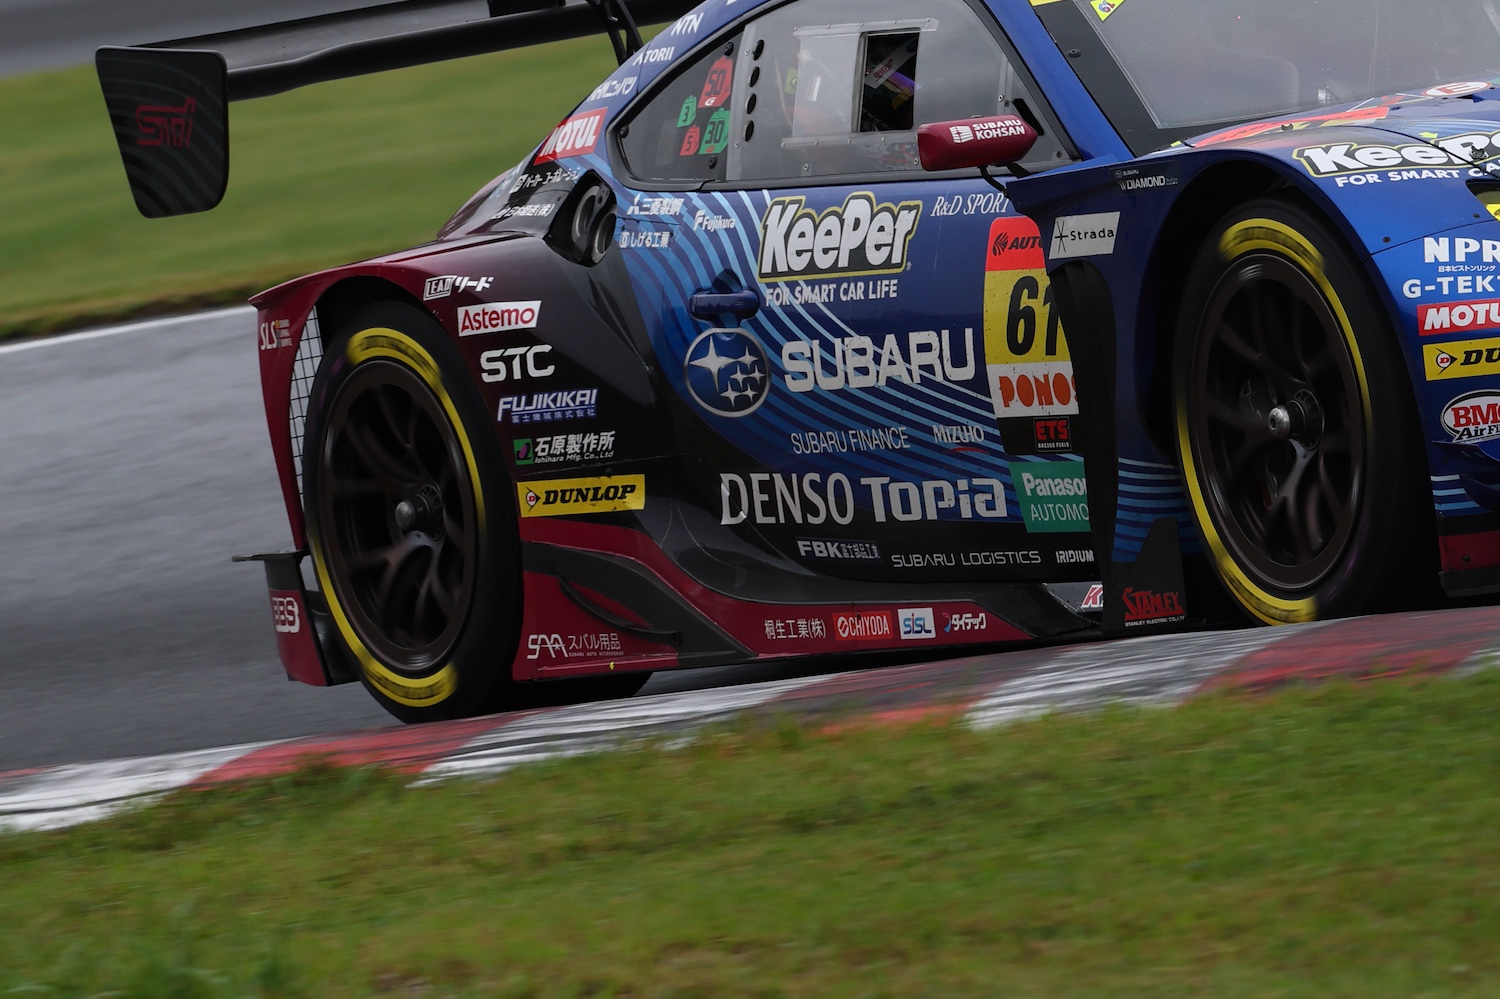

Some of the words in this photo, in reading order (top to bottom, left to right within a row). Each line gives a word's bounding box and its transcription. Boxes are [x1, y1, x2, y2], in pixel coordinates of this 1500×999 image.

[670, 12, 704, 36] NTN
[705, 70, 726, 96] 50
[538, 115, 602, 156] MOTUL
[705, 120, 725, 144] 30
[972, 118, 1022, 131] SUBARU
[975, 126, 1026, 141] KOHSAN
[1334, 173, 1382, 188] FOR
[1391, 169, 1461, 182] SMART
[930, 195, 962, 217] R&D
[1070, 227, 1115, 242] Strada
[1438, 265, 1496, 273] 日本ピストンリング
[427, 278, 453, 294] LEAD
[454, 276, 494, 293] リード
[765, 286, 790, 307] FOR
[793, 282, 837, 305] SMART
[839, 282, 867, 301] CAR
[869, 279, 898, 300] LIFE
[461, 306, 535, 333] Astemo
[260, 321, 277, 350] SLS
[480, 344, 555, 383] STC
[782, 327, 976, 393] SUBARU
[497, 388, 598, 422] FUJIKIKAI
[790, 432, 848, 456] SUBARU
[849, 427, 911, 452] FINANCE
[1035, 420, 1068, 441] ETS
[1457, 426, 1488, 441] Air
[534, 430, 616, 456] 石原製作所
[534, 455, 564, 463] Ishihara
[566, 453, 582, 462] Mfg.
[542, 484, 636, 506] DUNLOP
[720, 472, 854, 526] DENSO
[797, 540, 844, 558] FBK
[891, 553, 955, 568] SUBARU
[960, 550, 1041, 566] LOGISTICS
[1055, 549, 1095, 563] IRIDIUM
[1122, 587, 1185, 620] STANLEY
[764, 619, 826, 640] 桐生工業(株)
[849, 615, 890, 636] CHIYODA
[951, 612, 987, 632] ダイテック
